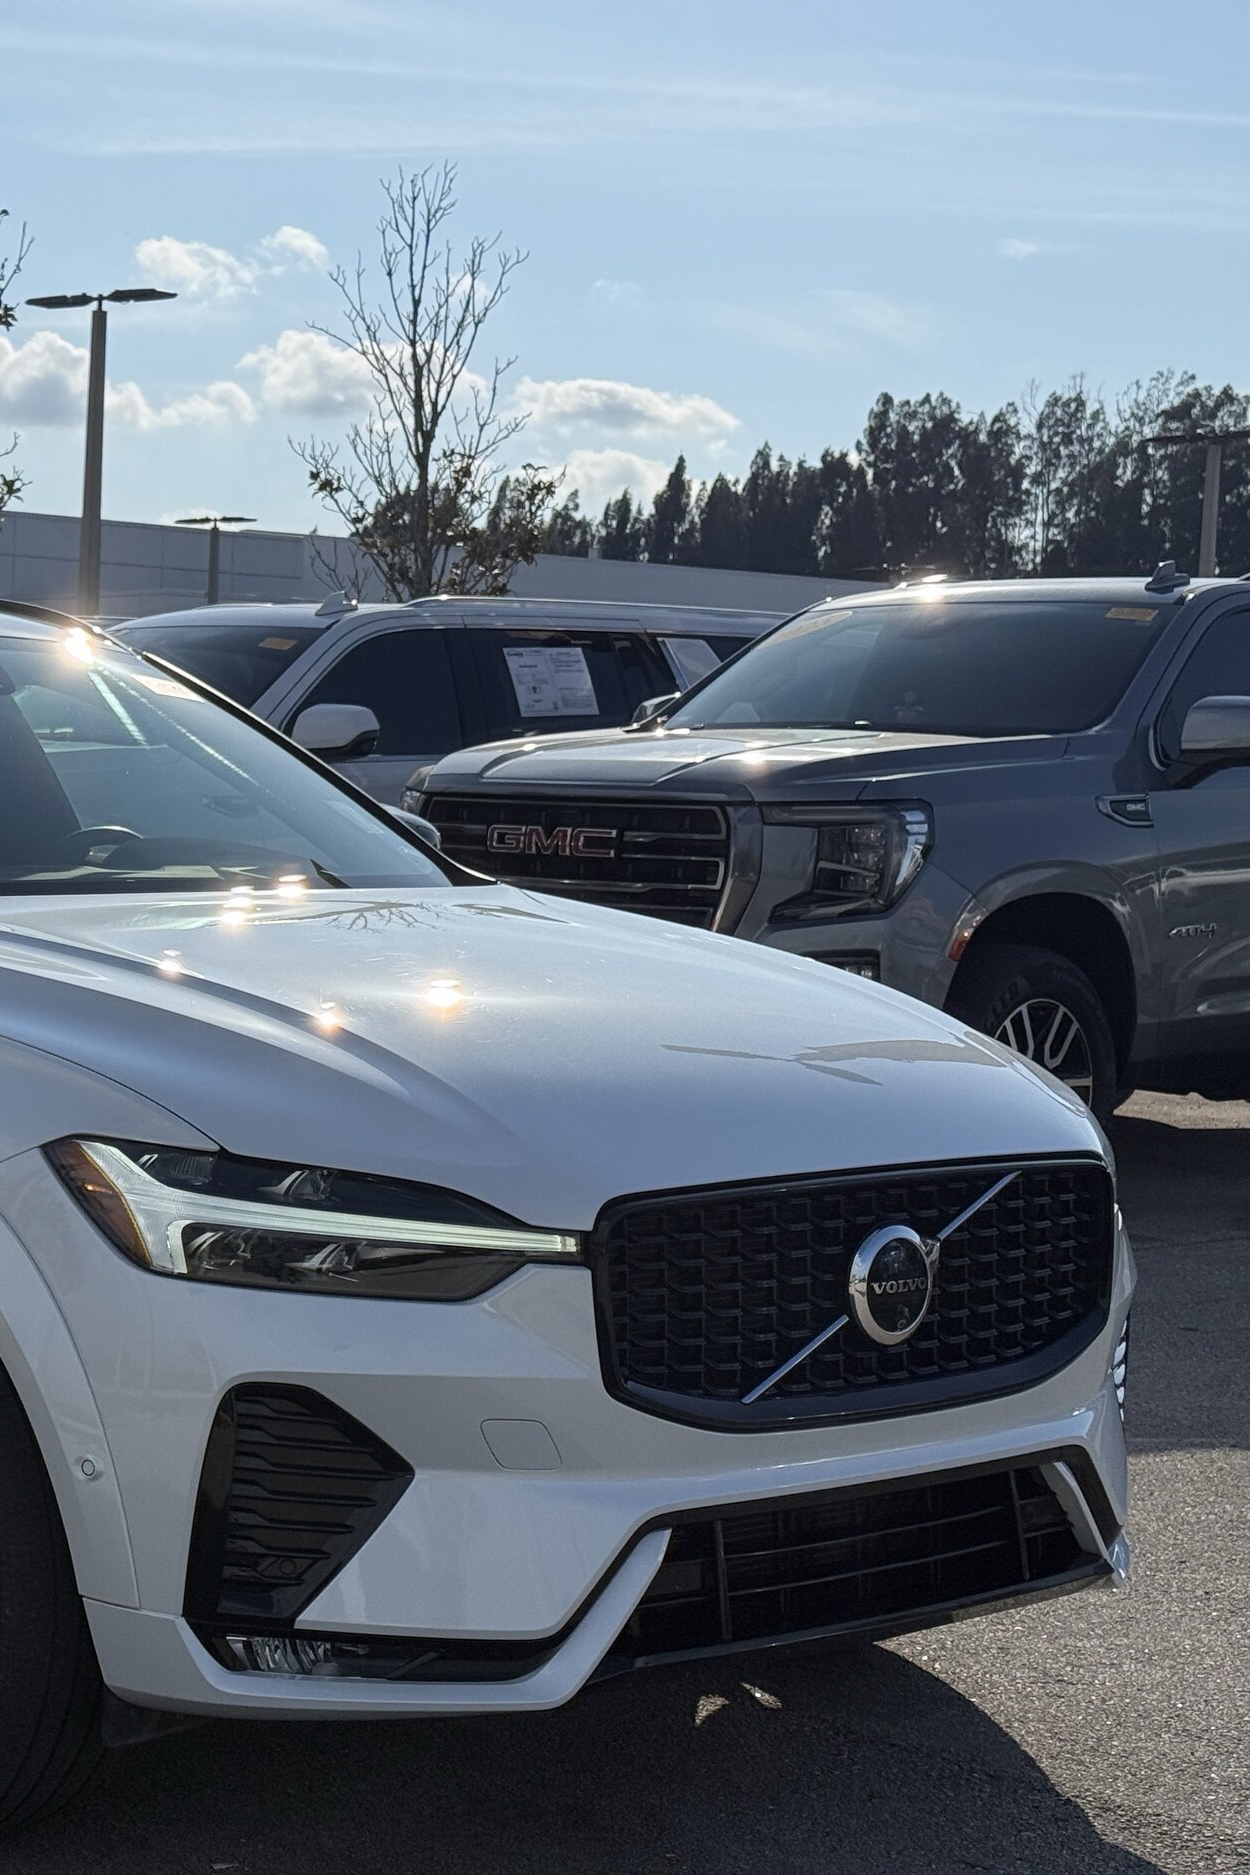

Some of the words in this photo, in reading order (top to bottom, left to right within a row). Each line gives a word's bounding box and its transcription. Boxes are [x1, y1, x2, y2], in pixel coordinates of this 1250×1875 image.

[1126, 803, 1146, 811] GMC
[487, 825, 617, 858] GMC
[870, 1277, 928, 1295] VOLVO
